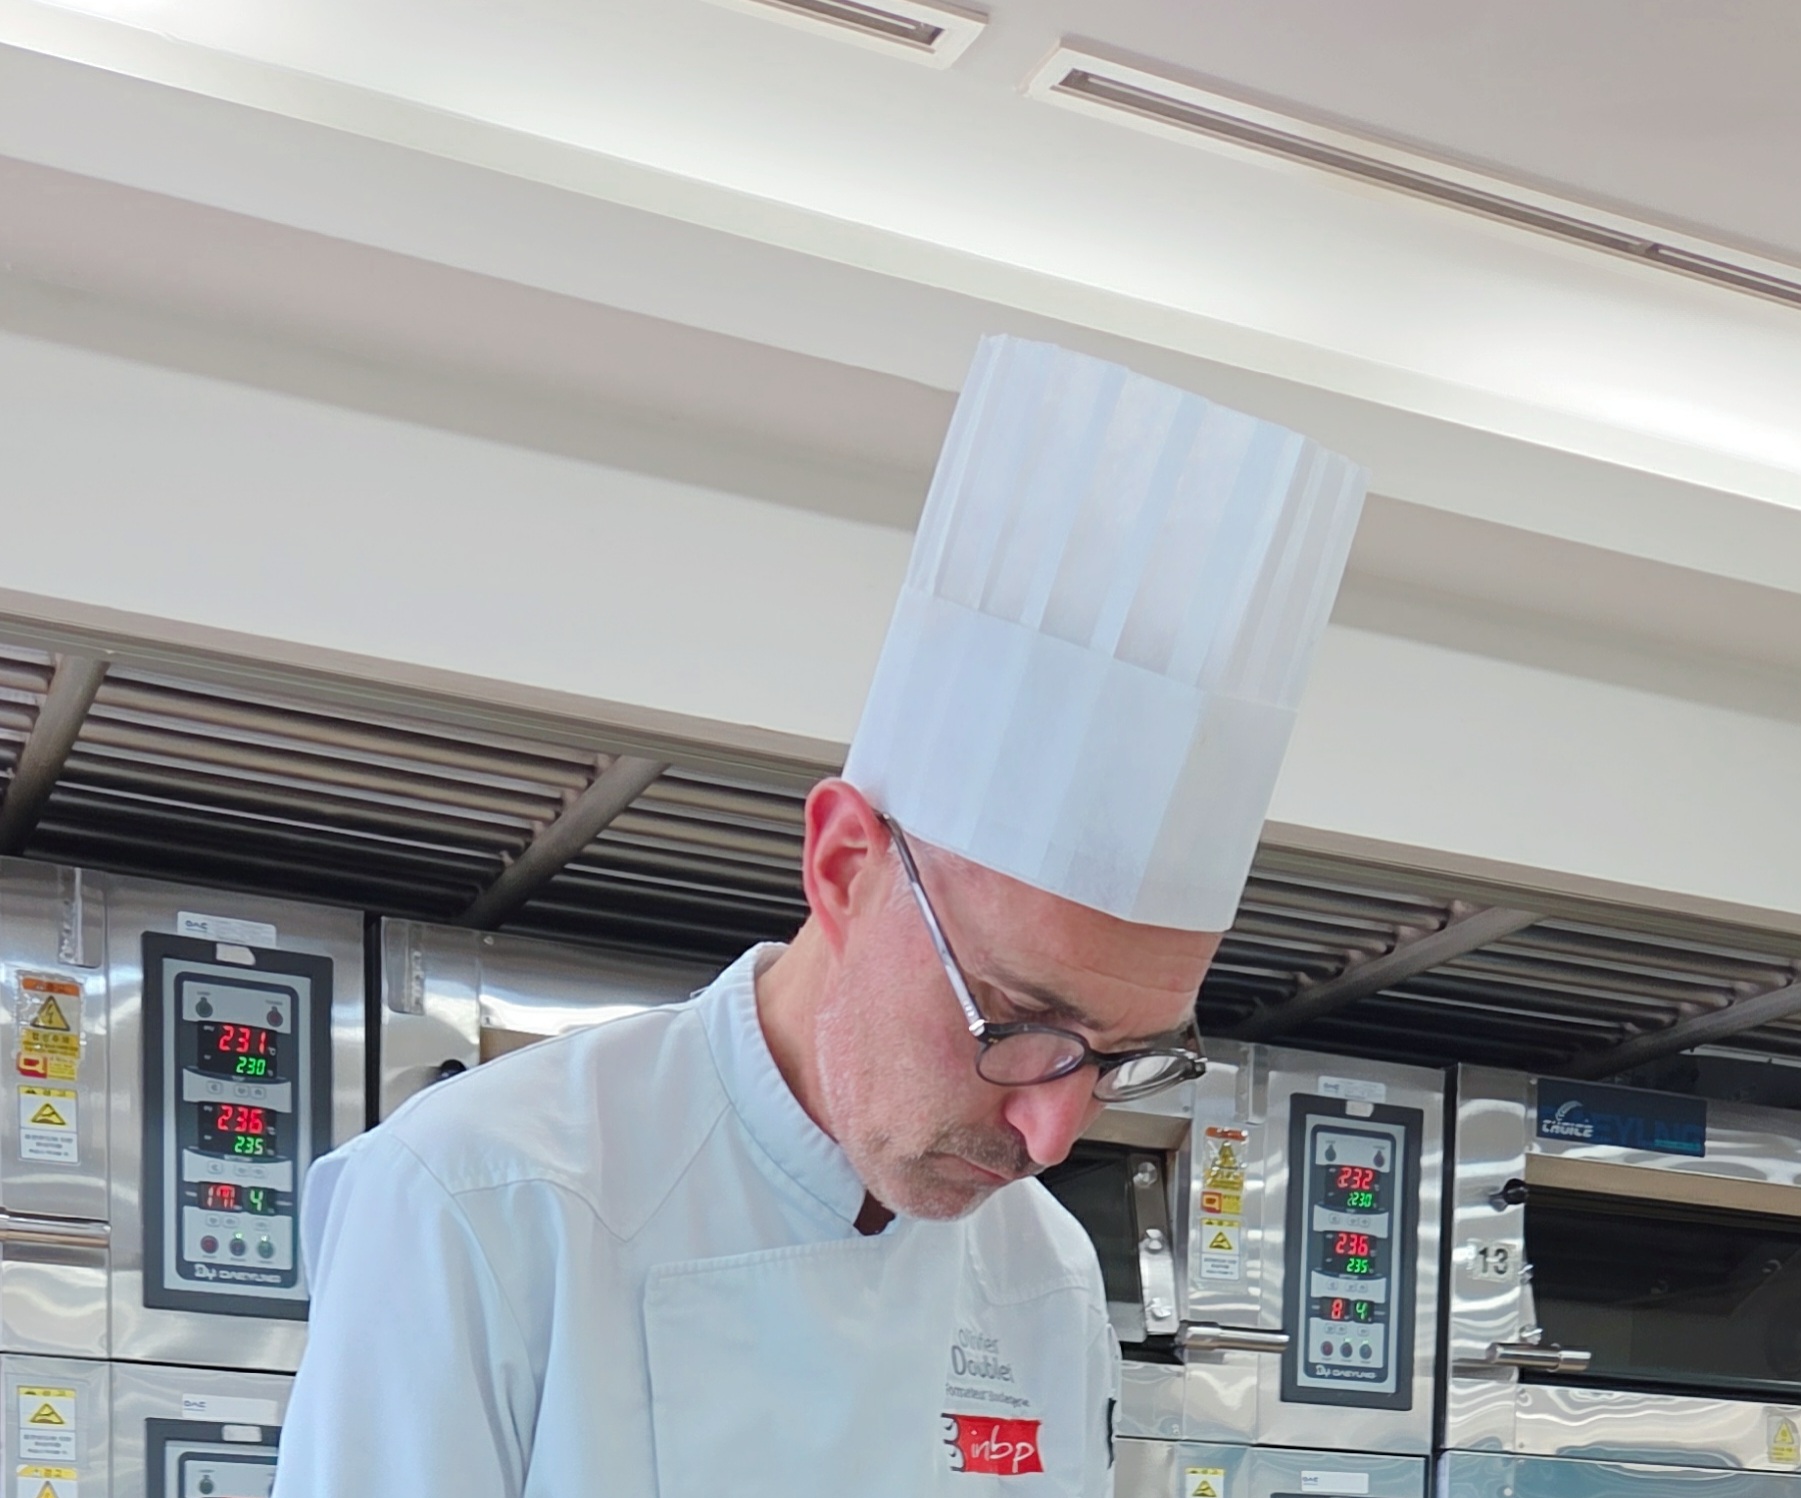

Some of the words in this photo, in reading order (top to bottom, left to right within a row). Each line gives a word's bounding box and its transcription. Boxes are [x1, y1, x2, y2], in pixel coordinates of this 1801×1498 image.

[218, 1025, 266, 1054] 231
[236, 1056, 266, 1075] 230
[217, 1105, 263, 1134] 236
[234, 1136, 264, 1155] 235
[1337, 1166, 1374, 1190] 232
[250, 1189, 264, 1211] 4
[1335, 1232, 1369, 1256] 236
[1346, 1258, 1369, 1273] 235
[1478, 1246, 1509, 1275] 13
[1331, 1298, 1343, 1320] 8
[1355, 1301, 1368, 1320] 4
[970, 1424, 1035, 1473] inbp
